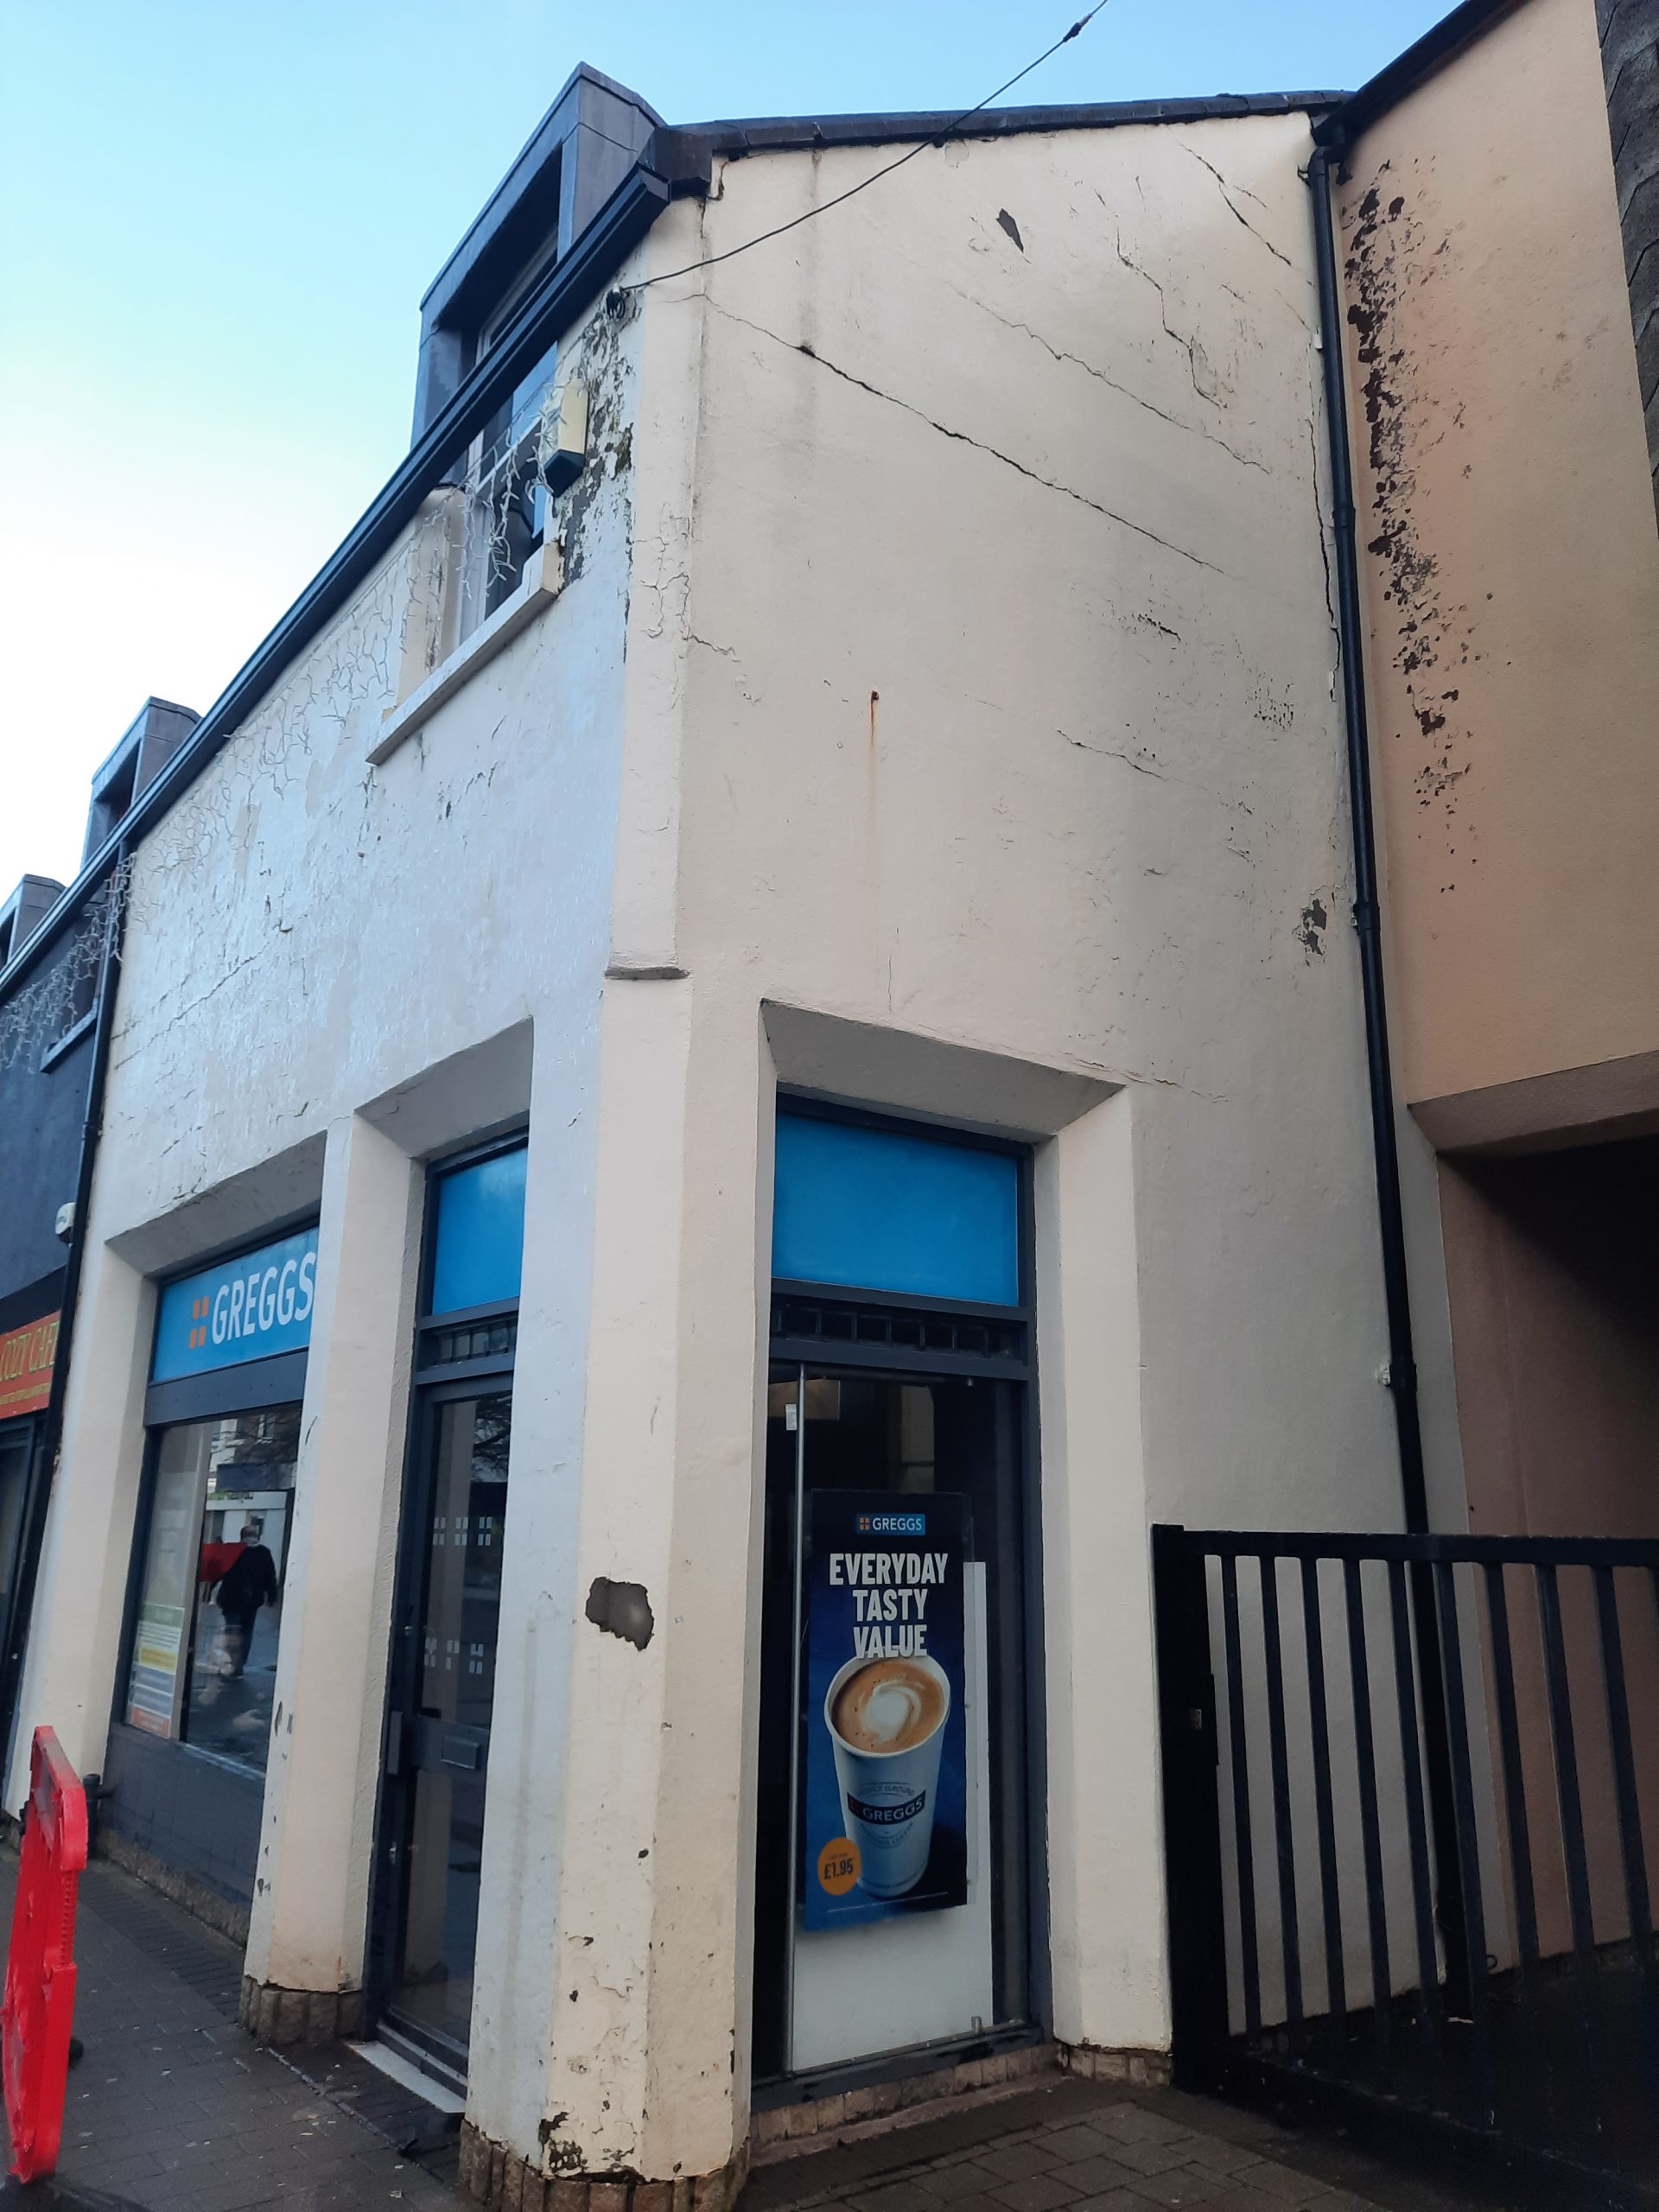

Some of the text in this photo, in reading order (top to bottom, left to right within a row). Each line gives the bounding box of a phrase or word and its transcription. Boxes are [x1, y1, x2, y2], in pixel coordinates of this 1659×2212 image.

[212, 1251, 317, 1344] GREGGS
[872, 1517, 923, 1531] GREGGS
[830, 1553, 949, 1586] EVERYDAY
[852, 1588, 929, 1622] TASTY
[853, 1624, 928, 1659] VALUE
[862, 1796, 924, 1821] GREGGS
[823, 1858, 854, 1880] £1.95
